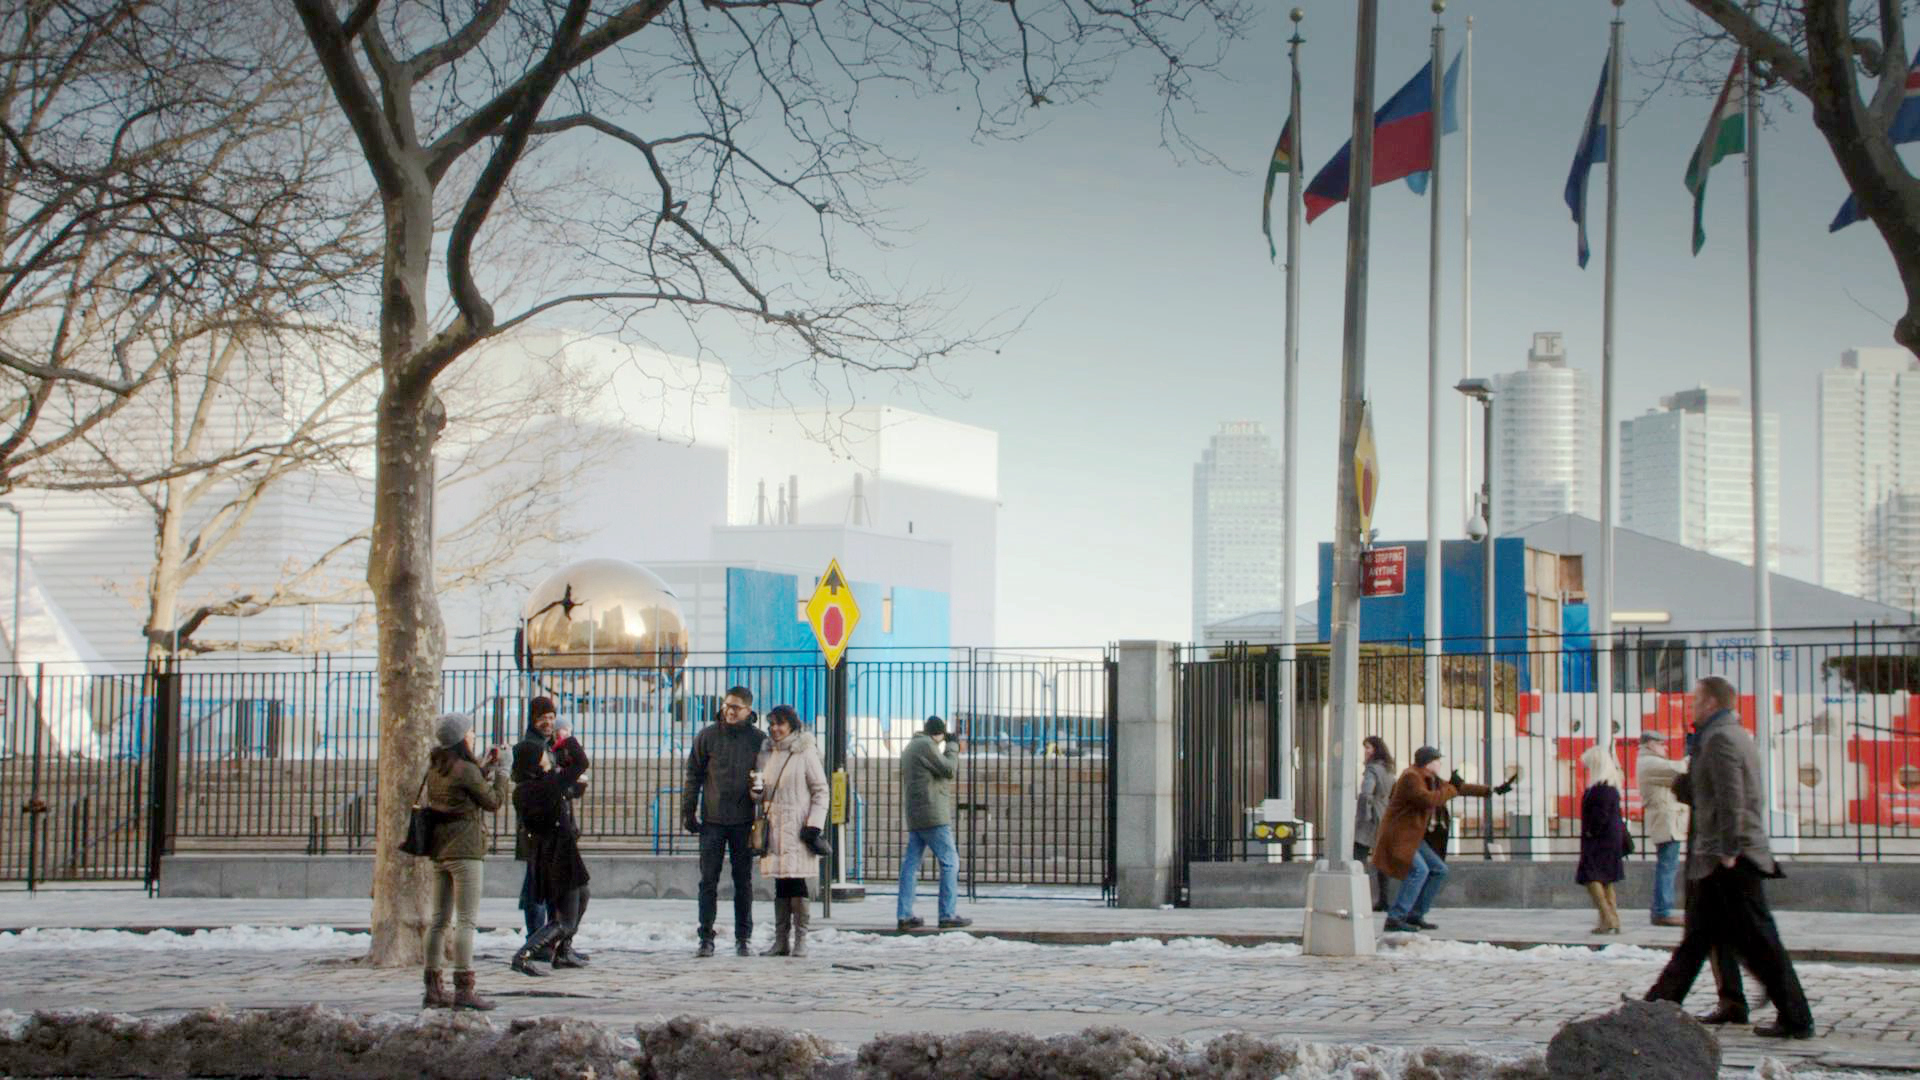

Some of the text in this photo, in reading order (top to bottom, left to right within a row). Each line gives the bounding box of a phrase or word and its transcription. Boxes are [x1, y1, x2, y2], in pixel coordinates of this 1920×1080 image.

[1375, 551, 1403, 563] STOPPING
[1368, 565, 1398, 576] ANYTIME
[1716, 650, 1792, 661] ENTRCE
